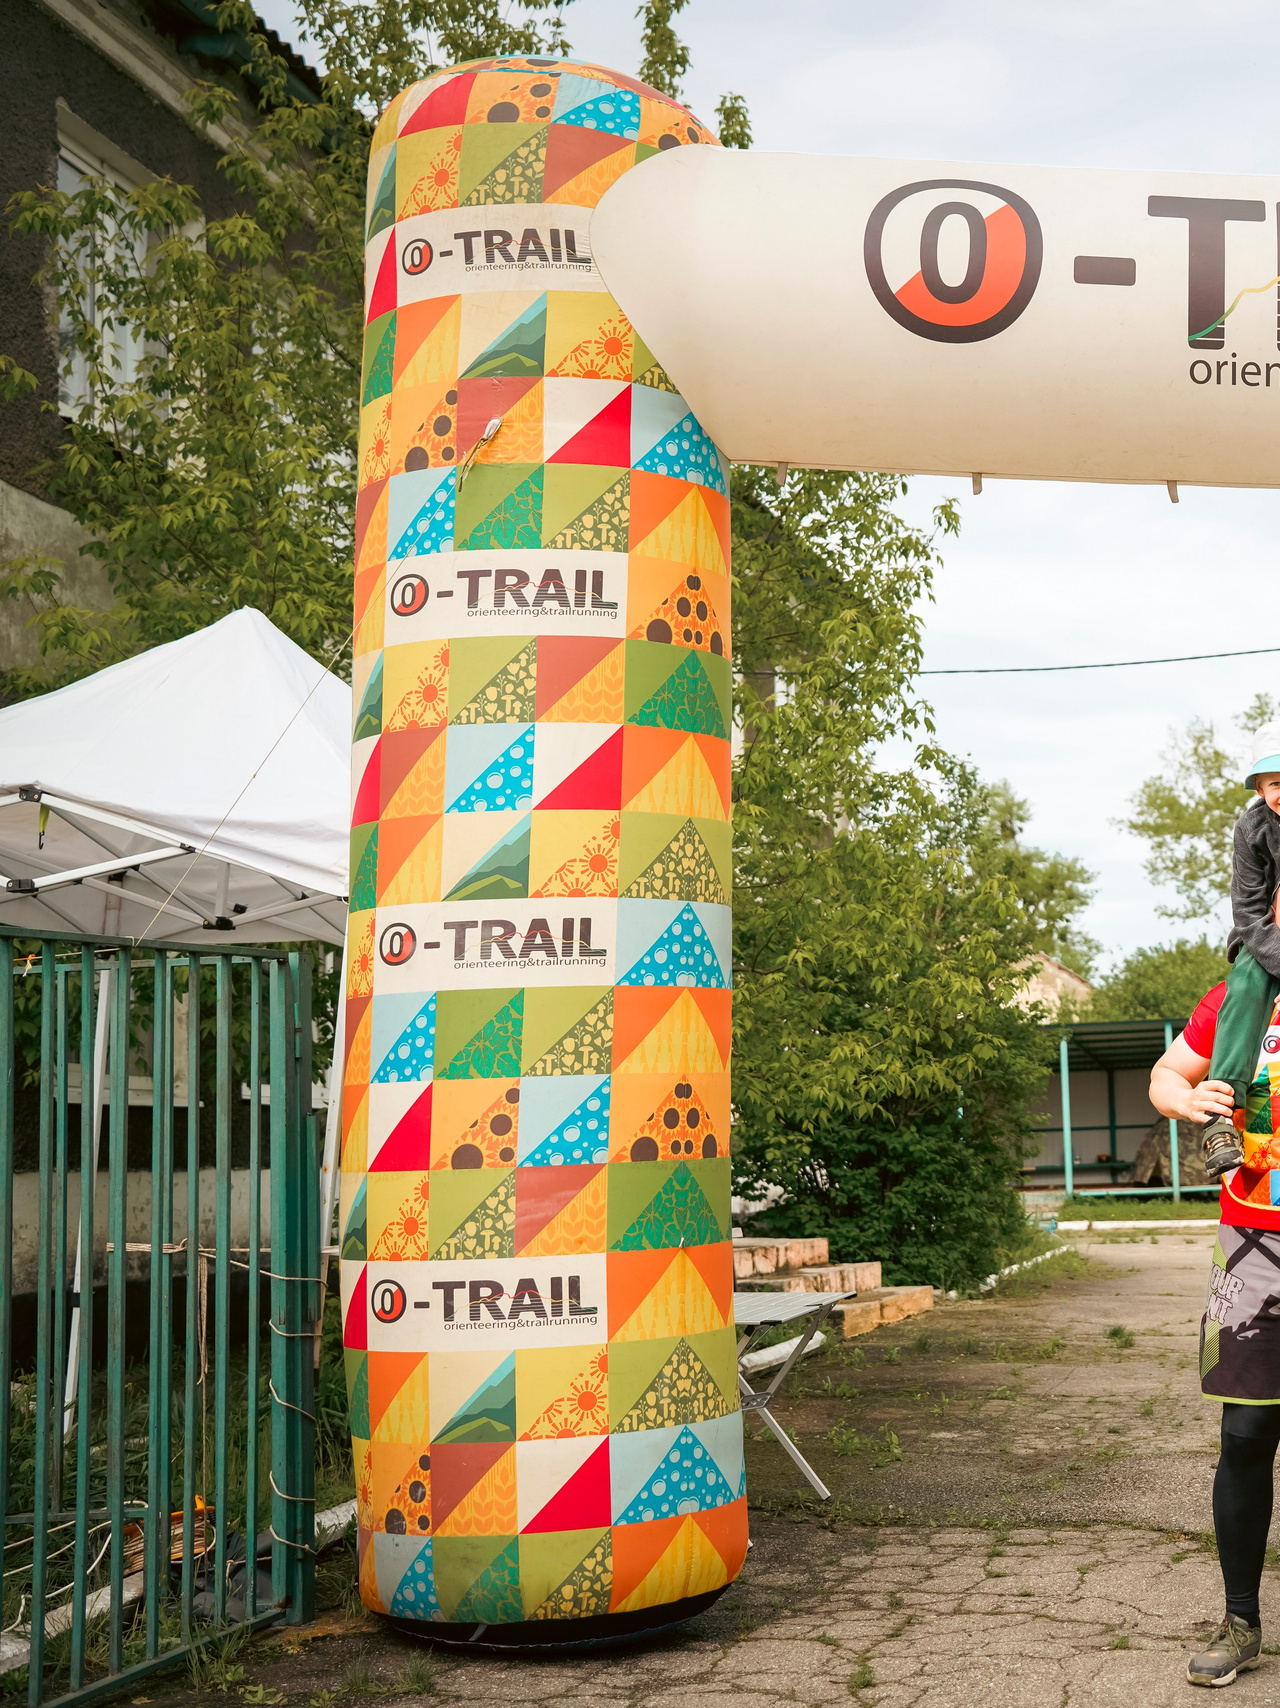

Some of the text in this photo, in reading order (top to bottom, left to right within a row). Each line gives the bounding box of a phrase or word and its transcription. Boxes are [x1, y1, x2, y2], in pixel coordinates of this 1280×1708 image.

[465, 261, 592, 272] orienteering&trailrunning
[467, 606, 618, 620] orienteering&trailrunning
[454, 956, 606, 969] orienteering&trailrunning
[444, 1314, 598, 1331] orienteering&trailrunning
